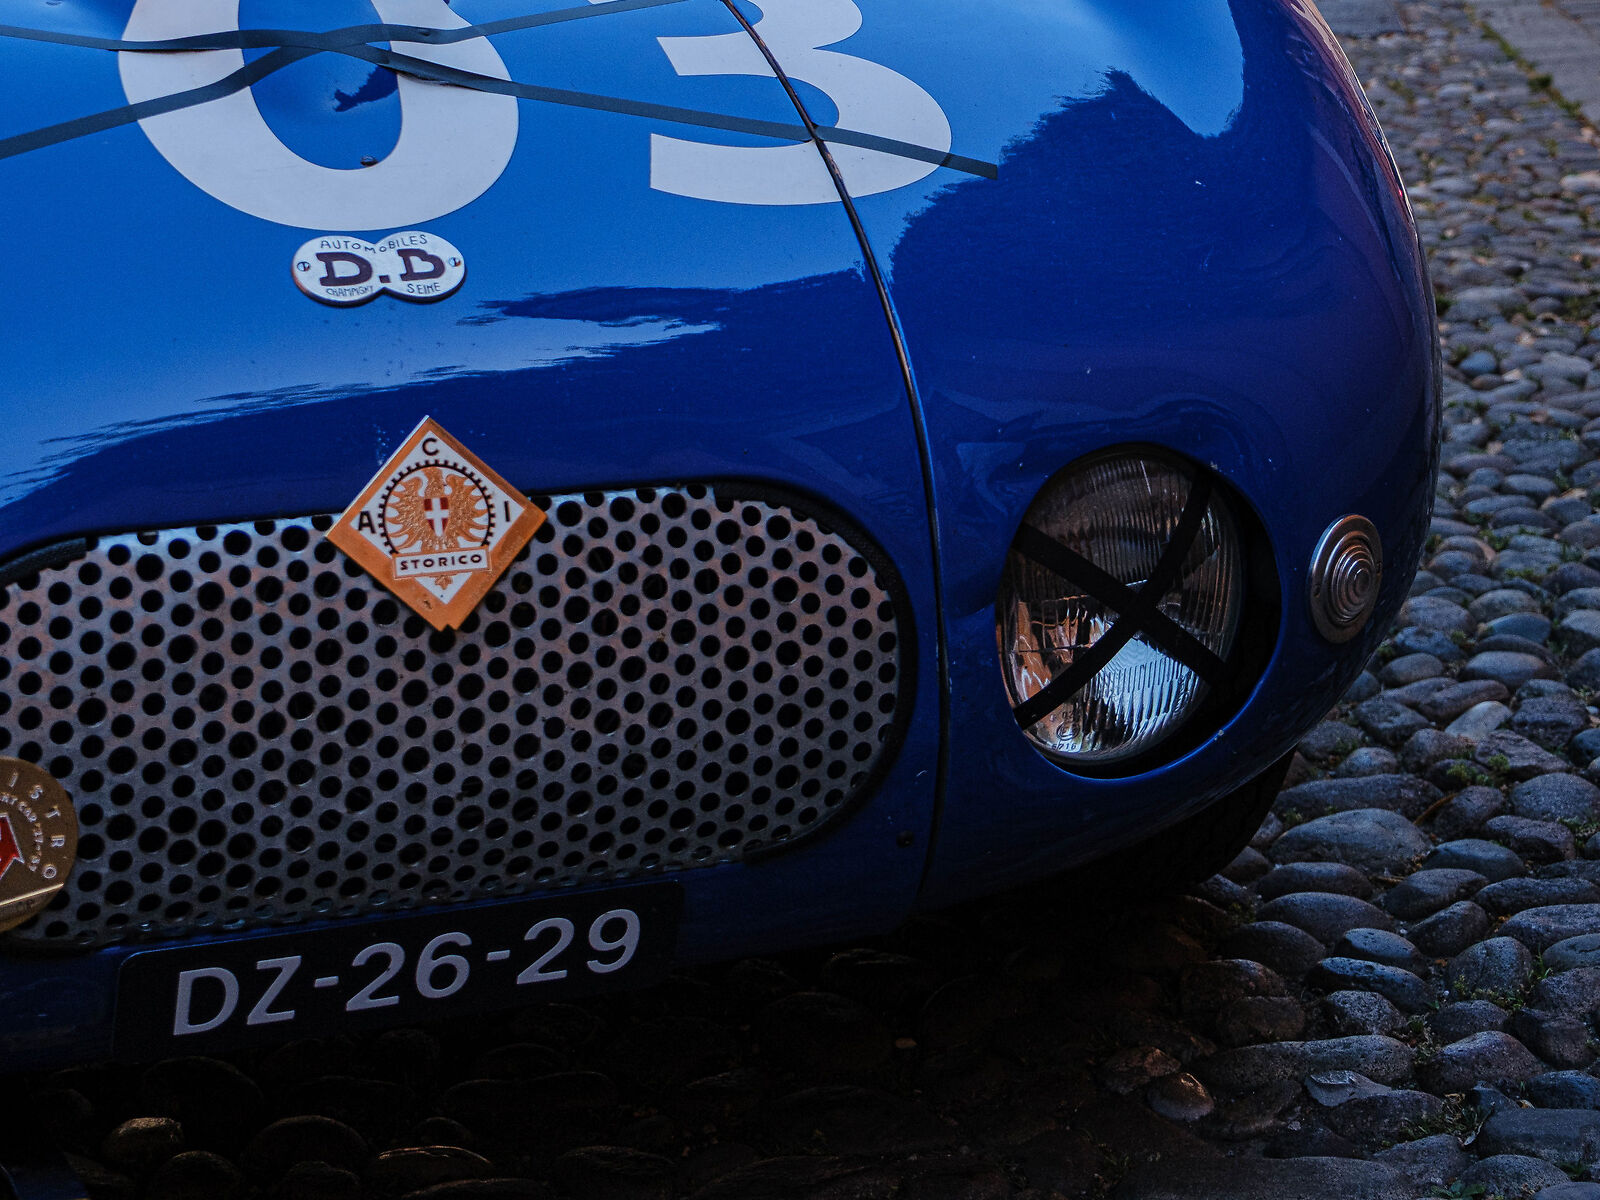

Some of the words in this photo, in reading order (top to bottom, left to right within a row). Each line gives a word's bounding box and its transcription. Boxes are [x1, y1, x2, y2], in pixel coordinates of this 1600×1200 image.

[320, 234, 428, 254] AUTOMOBILES
[407, 281, 441, 294] SEINE
[399, 552, 483, 571] STORICO
[172, 908, 641, 1037] DZ-26-29
